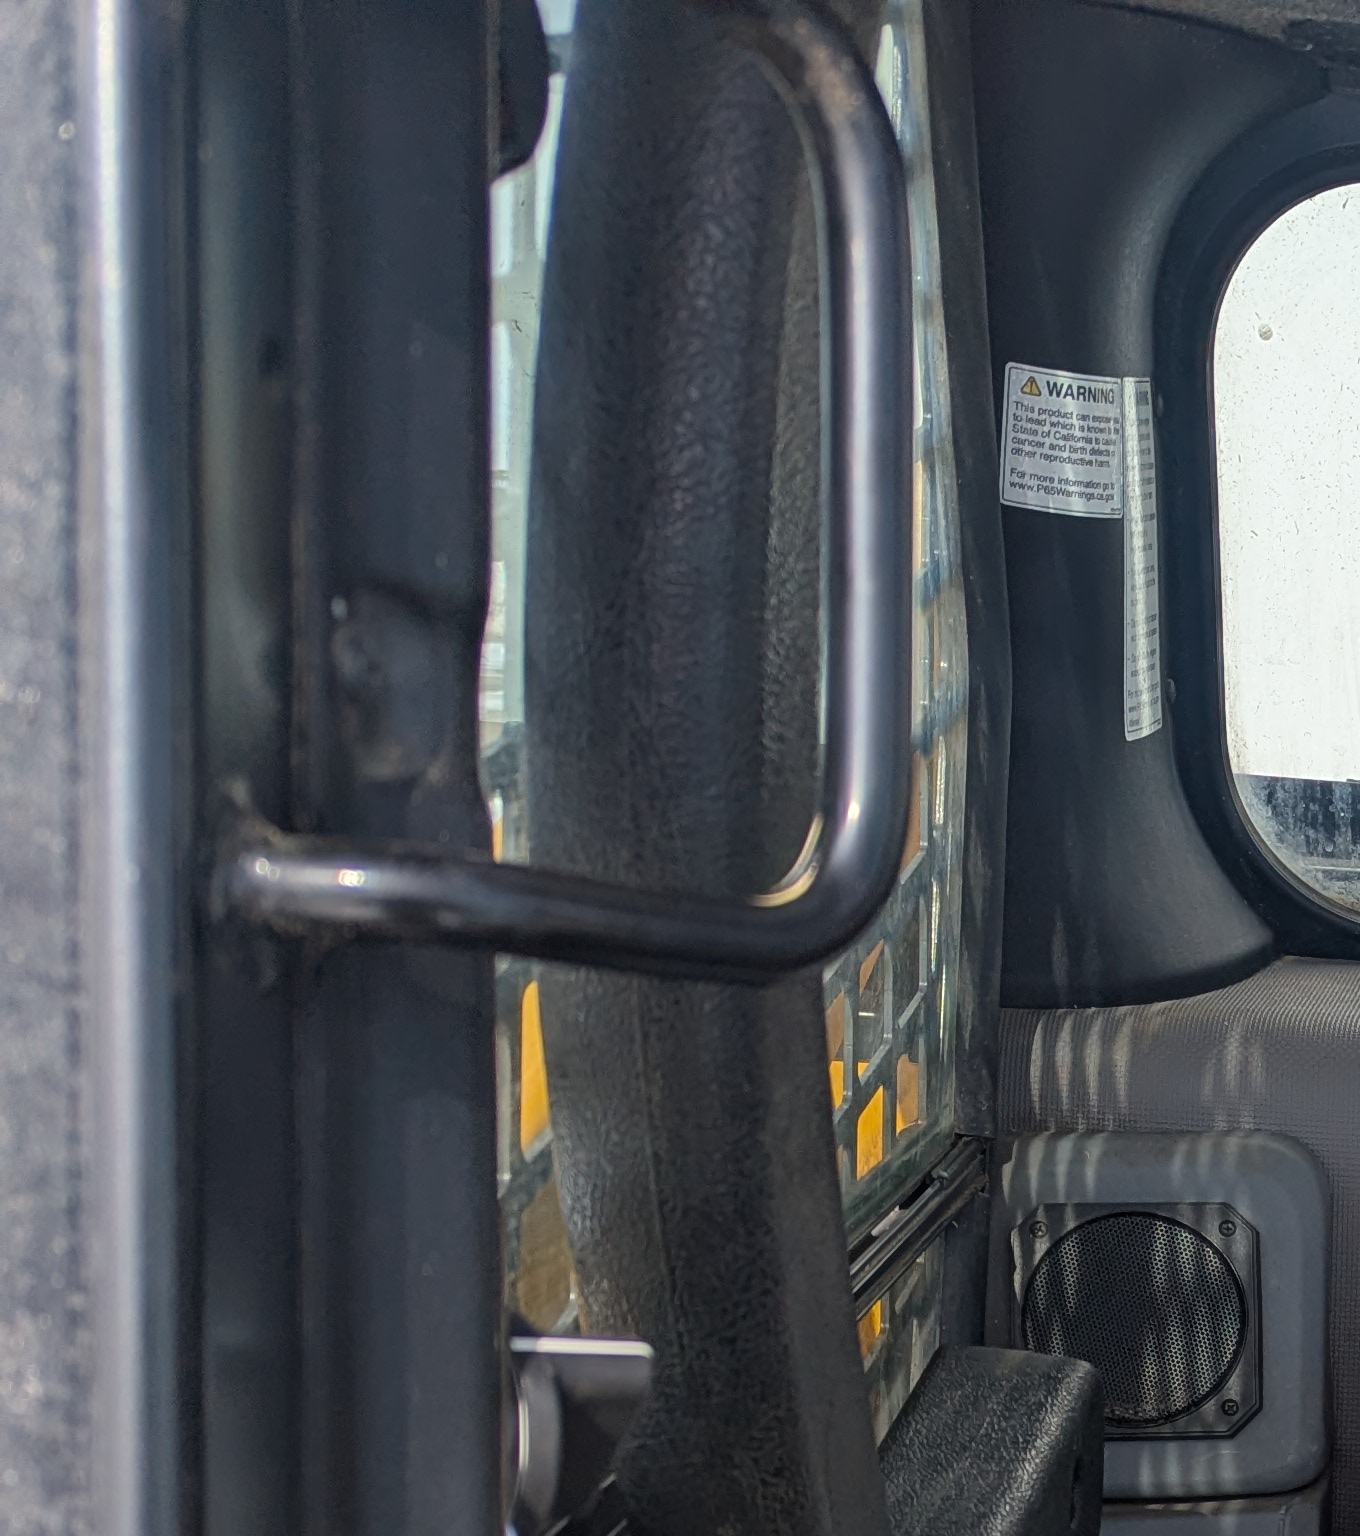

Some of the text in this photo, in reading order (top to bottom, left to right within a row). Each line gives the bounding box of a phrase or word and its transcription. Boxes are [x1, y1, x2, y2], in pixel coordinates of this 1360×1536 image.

[1046, 380, 1114, 405] WARNING
[1013, 401, 1035, 414] This
[1038, 408, 1073, 420] product
[1013, 413, 1022, 422] to
[1025, 415, 1047, 426] lead
[1049, 420, 1076, 431] which
[1012, 424, 1039, 437] State
[1041, 430, 1051, 439] of
[1054, 432, 1093, 445] California
[1012, 436, 1045, 449] cancer
[1049, 443, 1066, 452] and
[1011, 447, 1037, 459] other
[1040, 453, 1094, 467] reproductive
[1010, 468, 1026, 480] For
[1030, 473, 1055, 484] more
[1058, 476, 1102, 489] information
